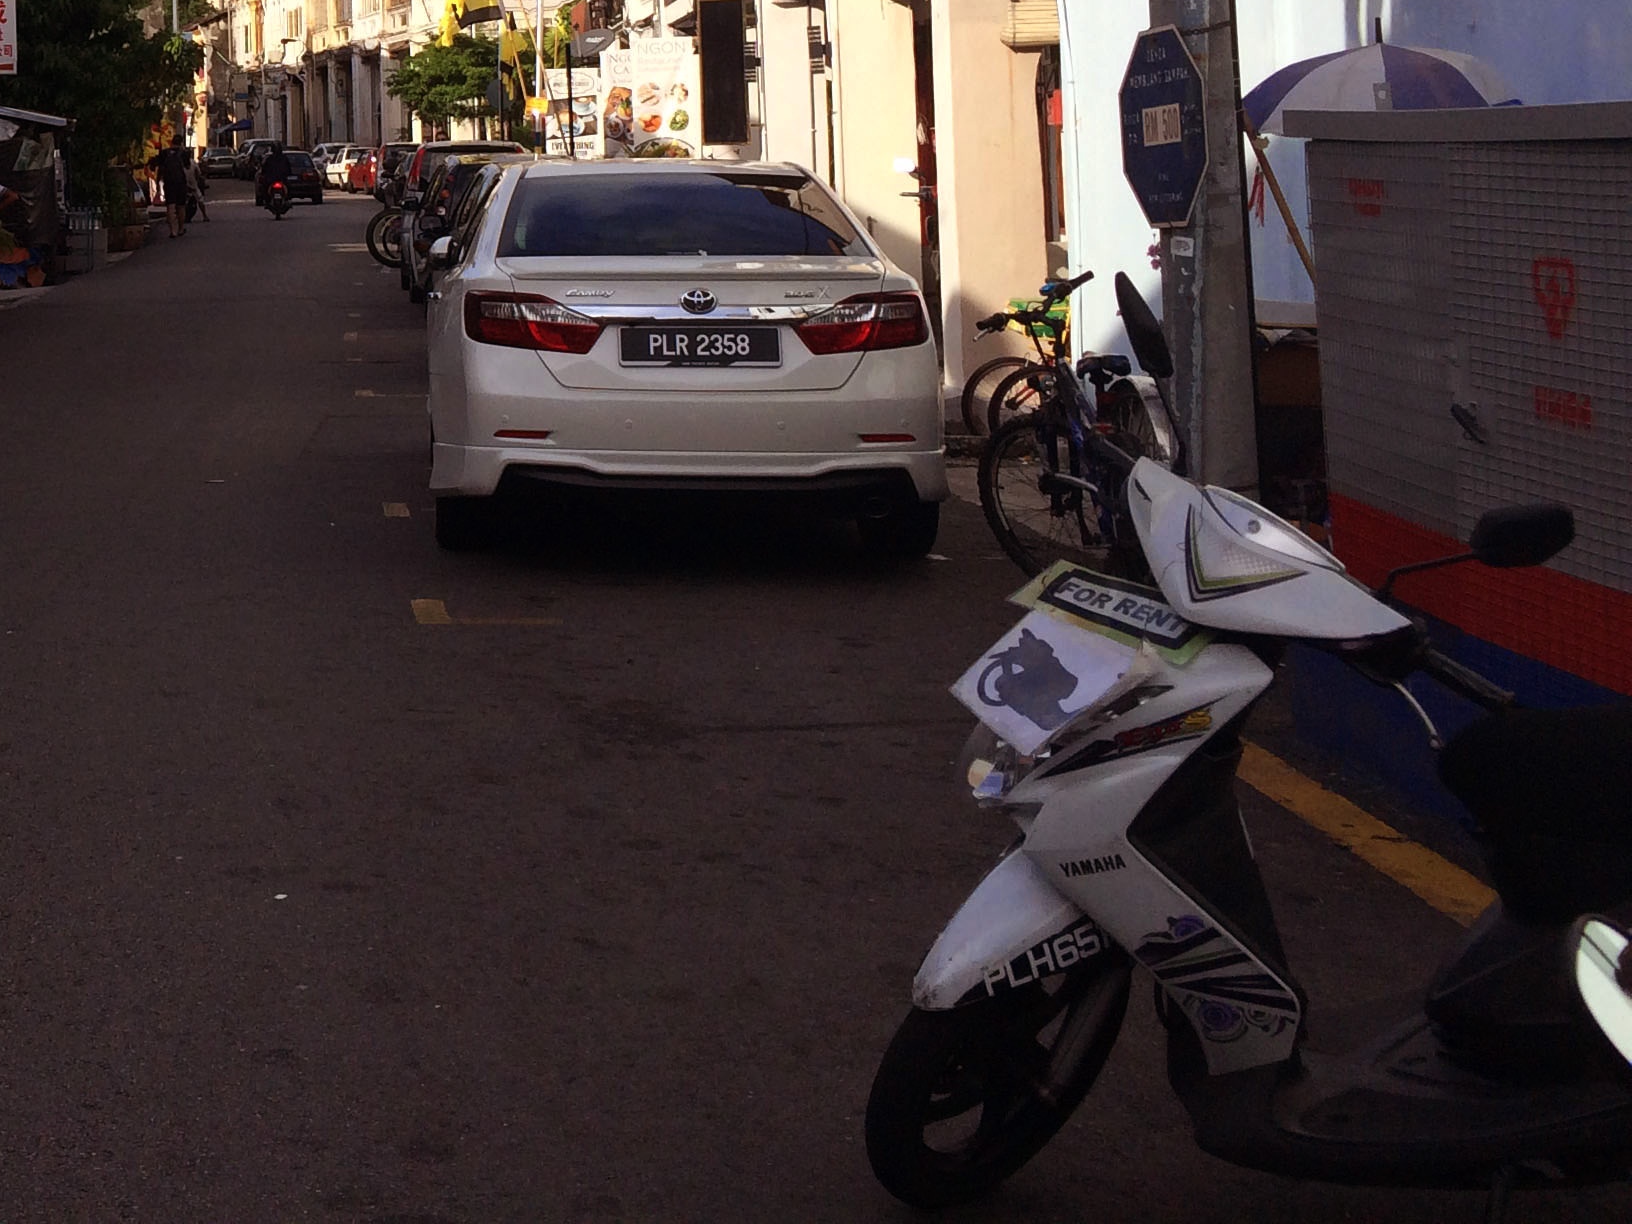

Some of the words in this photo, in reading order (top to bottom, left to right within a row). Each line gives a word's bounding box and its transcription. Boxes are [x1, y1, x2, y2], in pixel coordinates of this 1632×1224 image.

[636, 41, 687, 55] NGON
[1144, 111, 1159, 143] RM
[1161, 107, 1180, 141] 500
[649, 334, 689, 356] PLR
[696, 334, 751, 356] 2358
[1053, 581, 1114, 610] FOR
[1113, 598, 1186, 633] RENT
[1059, 854, 1127, 878] YAMAHA
[982, 920, 1111, 998] PLH65
